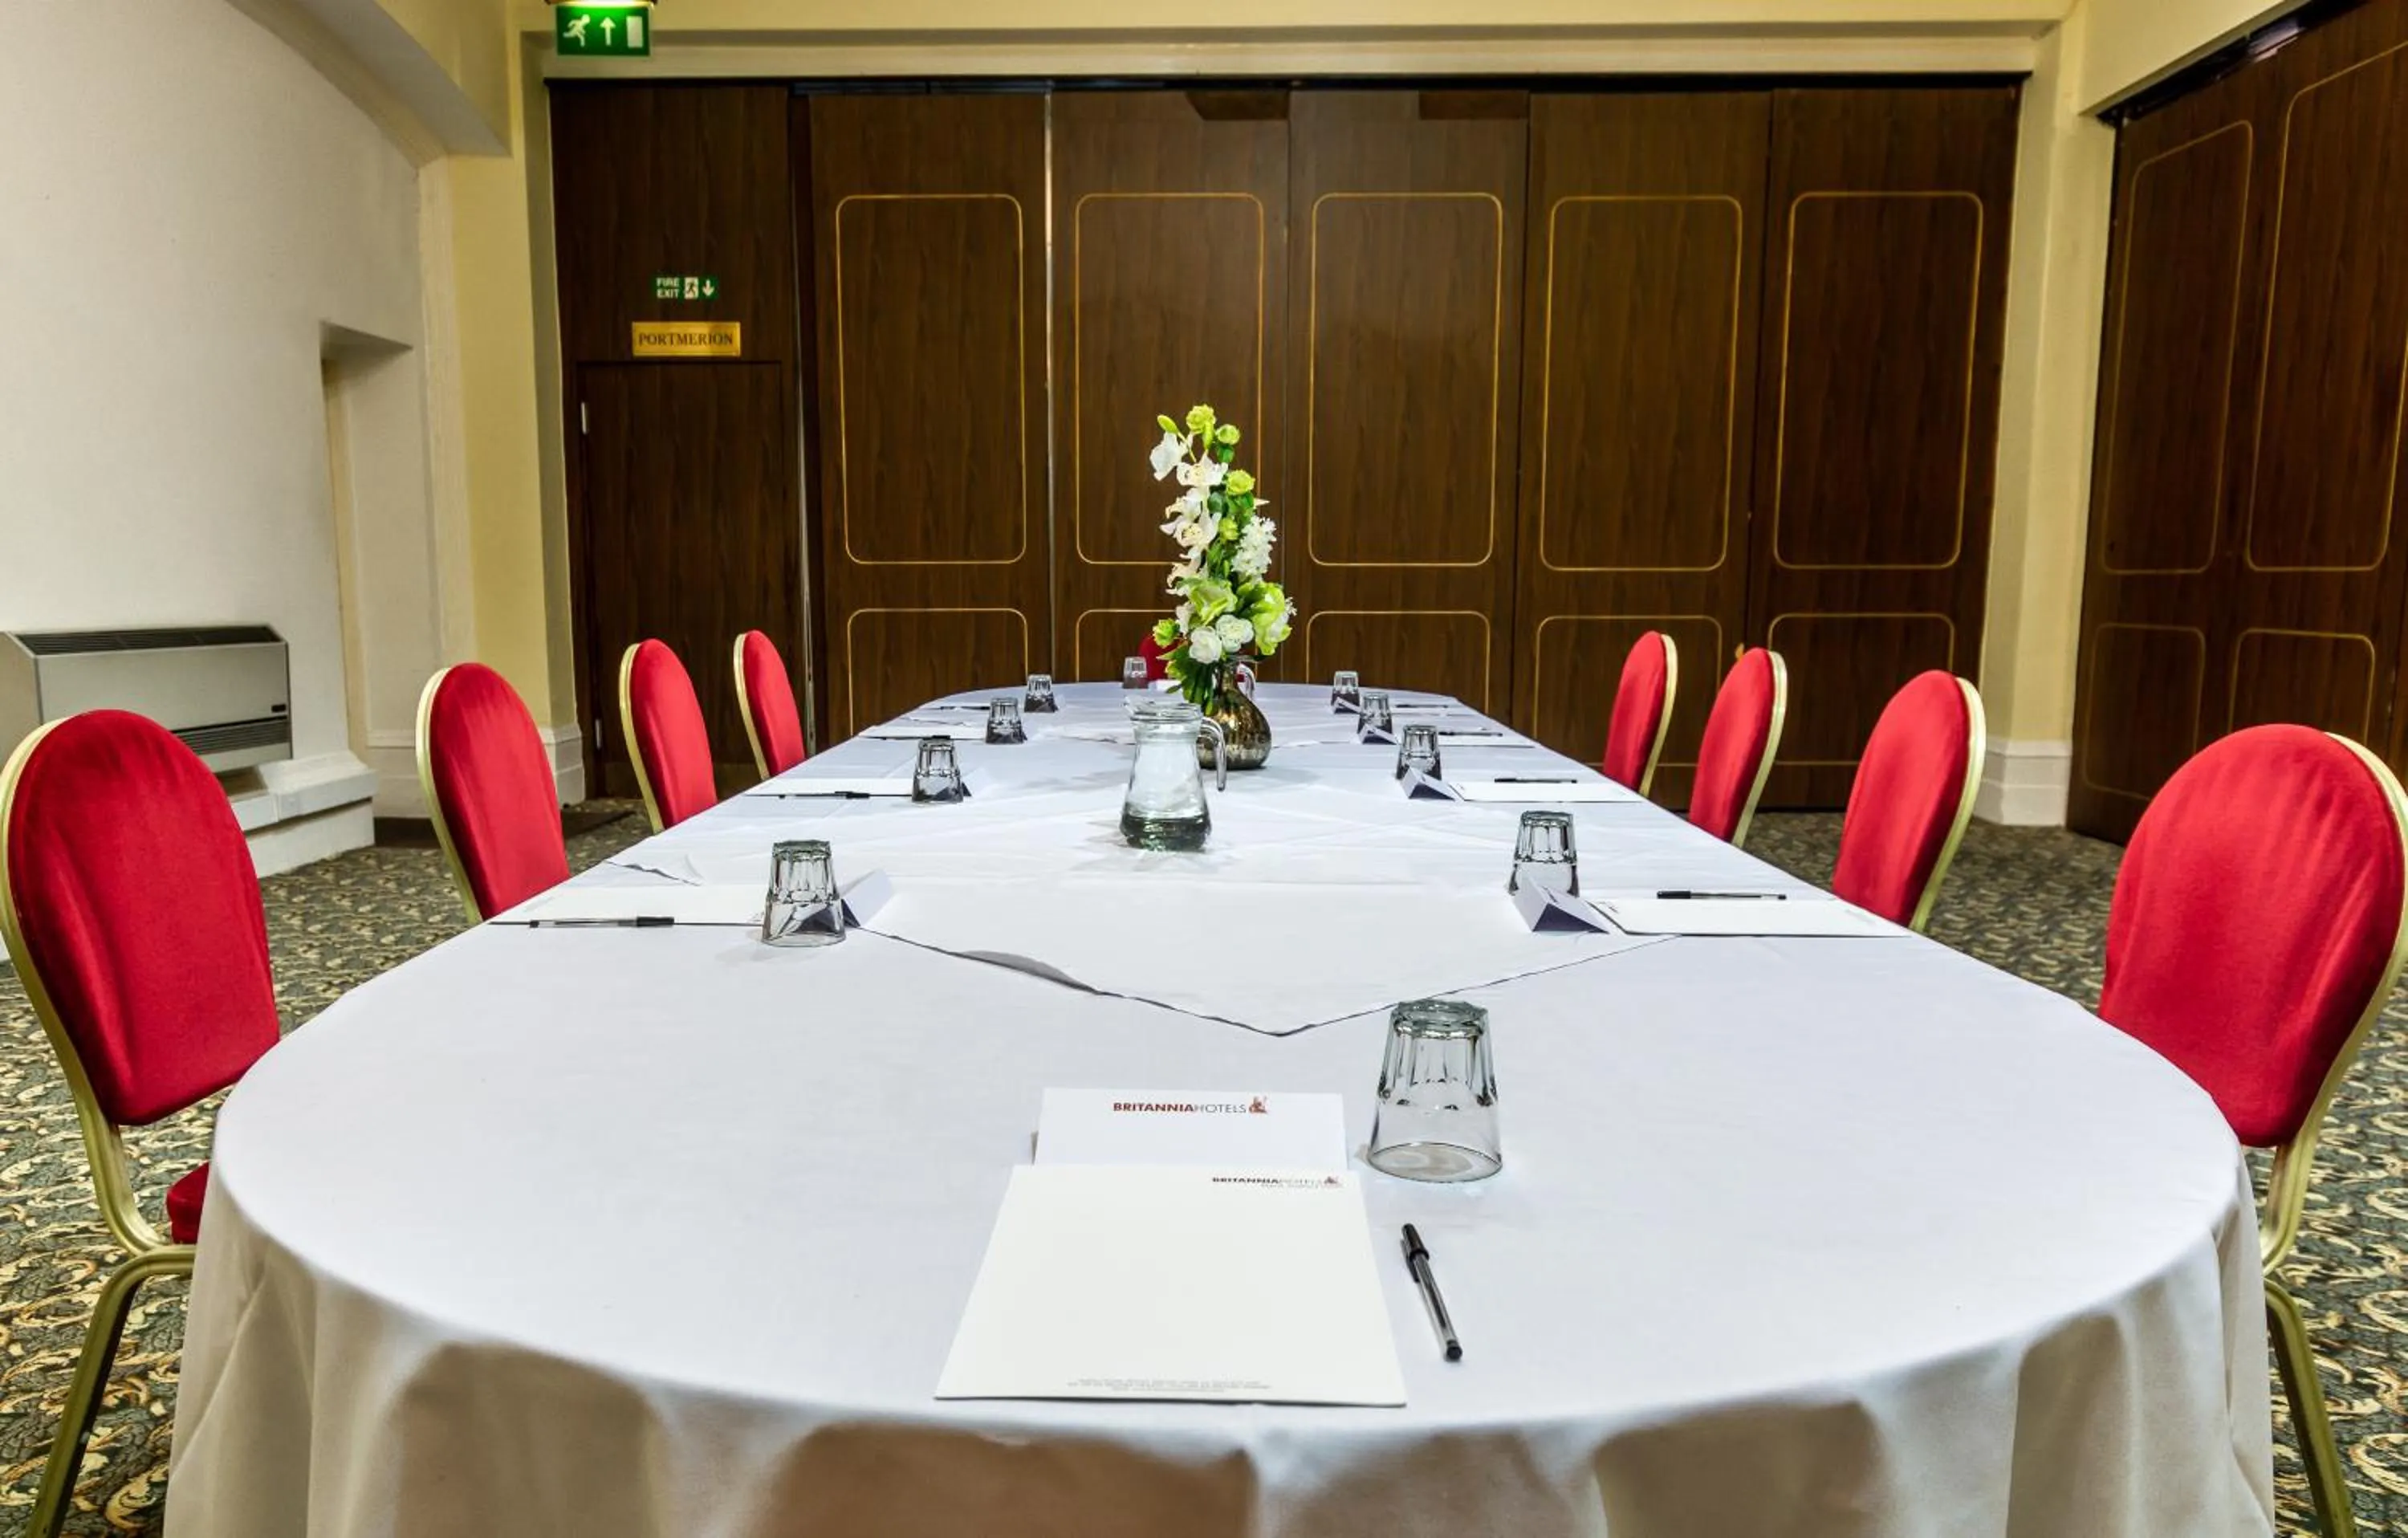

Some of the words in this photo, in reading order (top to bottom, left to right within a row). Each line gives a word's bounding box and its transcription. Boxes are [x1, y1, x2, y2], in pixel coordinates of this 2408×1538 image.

[656, 277, 680, 287] FIRE
[657, 288, 680, 299] EXIT
[639, 332, 733, 346] PORTMERION
